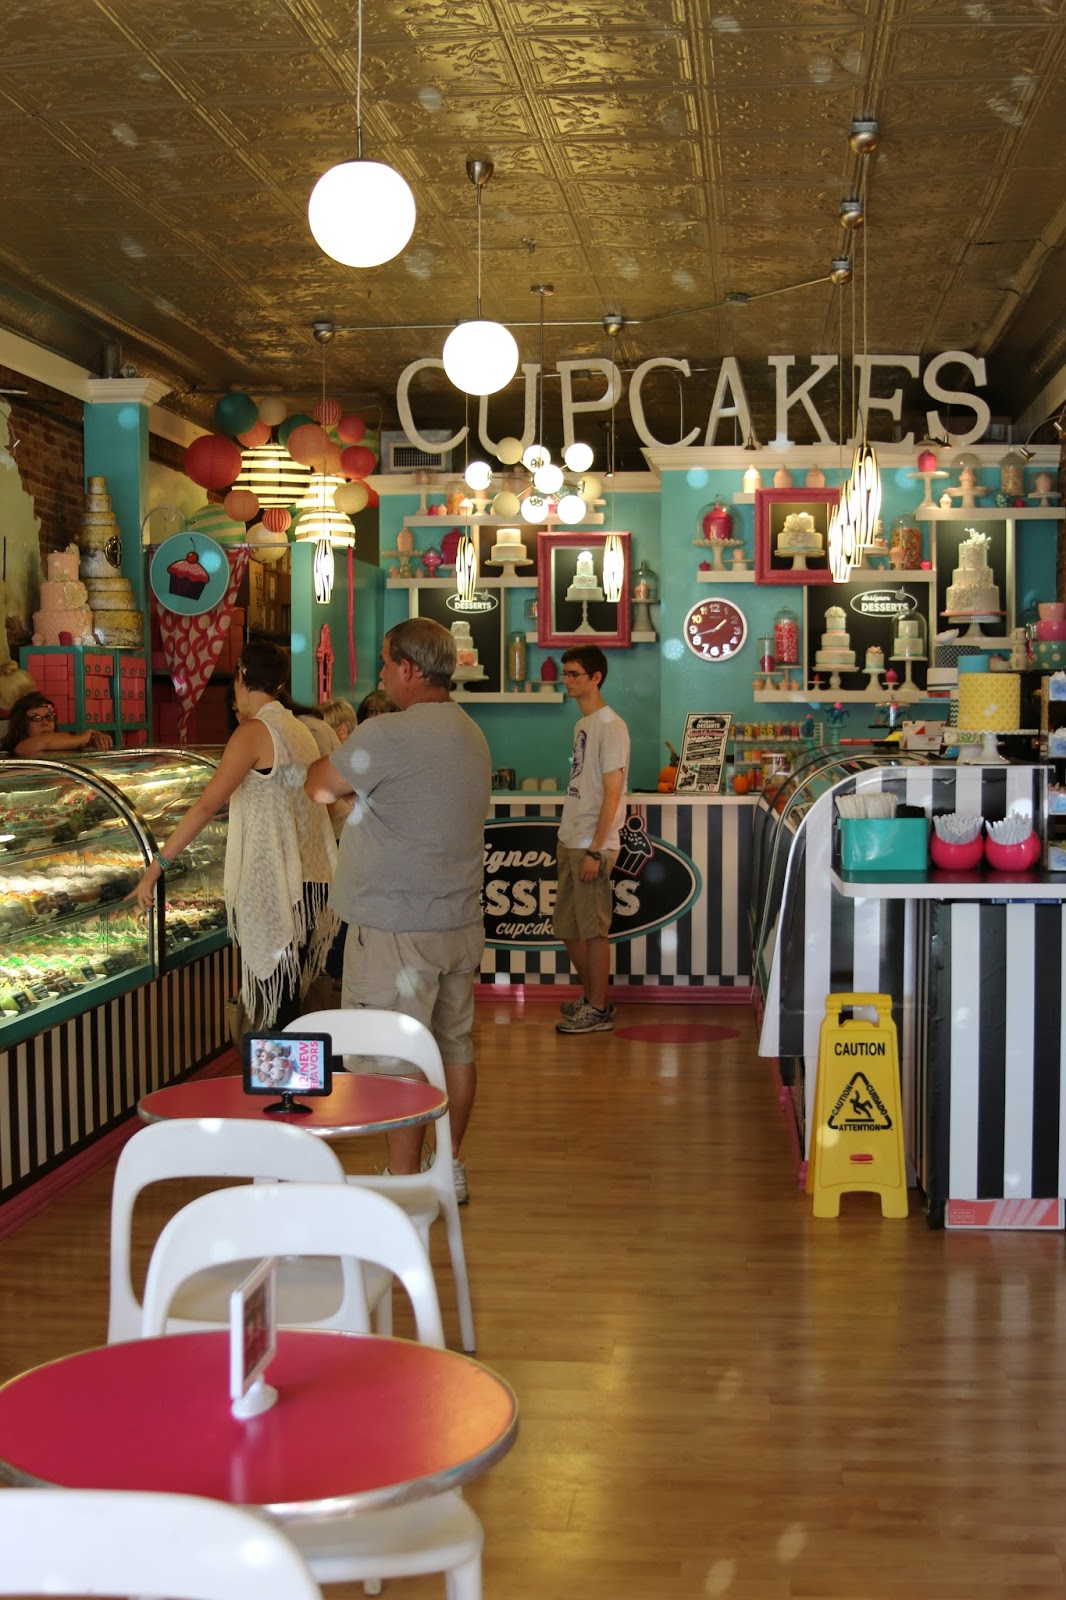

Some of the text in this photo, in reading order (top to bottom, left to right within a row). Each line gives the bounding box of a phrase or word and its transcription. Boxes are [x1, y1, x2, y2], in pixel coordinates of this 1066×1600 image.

[396, 351, 991, 457] CUPCAKES
[454, 602, 492, 610] DESSERTS
[709, 604, 720, 613] 12
[861, 602, 909, 612] DESSERTS
[692, 615, 702, 624] 10
[731, 616, 737, 624] 2
[689, 625, 698, 635] 9
[734, 626, 741, 635] 3
[692, 635, 702, 646] 8
[730, 636, 738, 644] 4
[702, 643, 710, 653] 7
[710, 646, 720, 656] 6
[722, 644, 731, 653] 5
[483, 843, 556, 874] igner
[479, 878, 640, 918] SSES
[834, 1042, 886, 1056] CAUTION
[299, 1041, 309, 1073] NEW
[310, 1040, 319, 1089] FLAVORS
[831, 1084, 853, 1116] CAUTION
[865, 1084, 888, 1116] CUIDADO
[838, 1123, 881, 1131] ATTENTION
